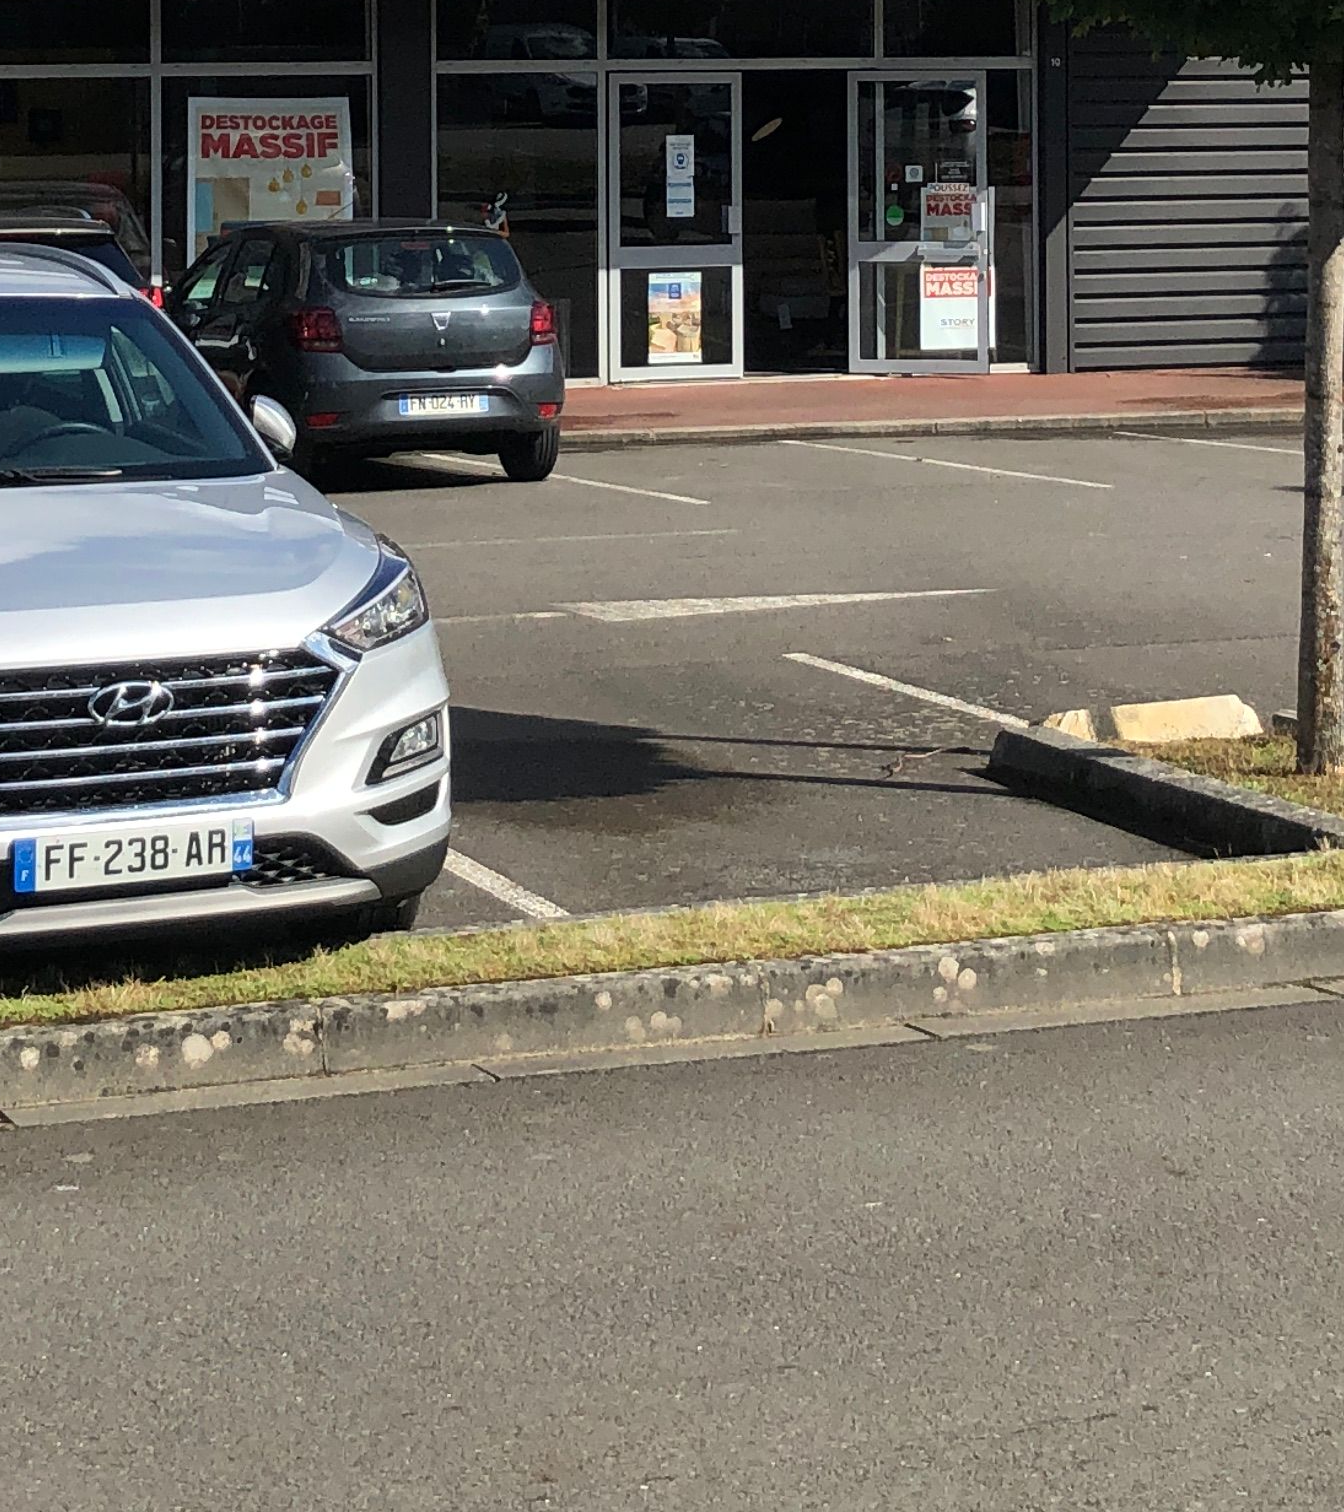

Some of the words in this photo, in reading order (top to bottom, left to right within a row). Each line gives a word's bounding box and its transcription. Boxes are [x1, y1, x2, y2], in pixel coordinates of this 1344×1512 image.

[201, 115, 338, 130] DESTOCKAGE
[201, 132, 338, 159] MASSIF
[926, 194, 977, 202] DESTOCKA
[927, 202, 972, 216] MASS
[926, 272, 977, 281] DESTOCKA
[926, 281, 977, 296] MASSI
[940, 318, 975, 326] STORY
[21, 870, 29, 881] F
[44, 828, 226, 881] FF-238-AR
[234, 845, 251, 863] 44
